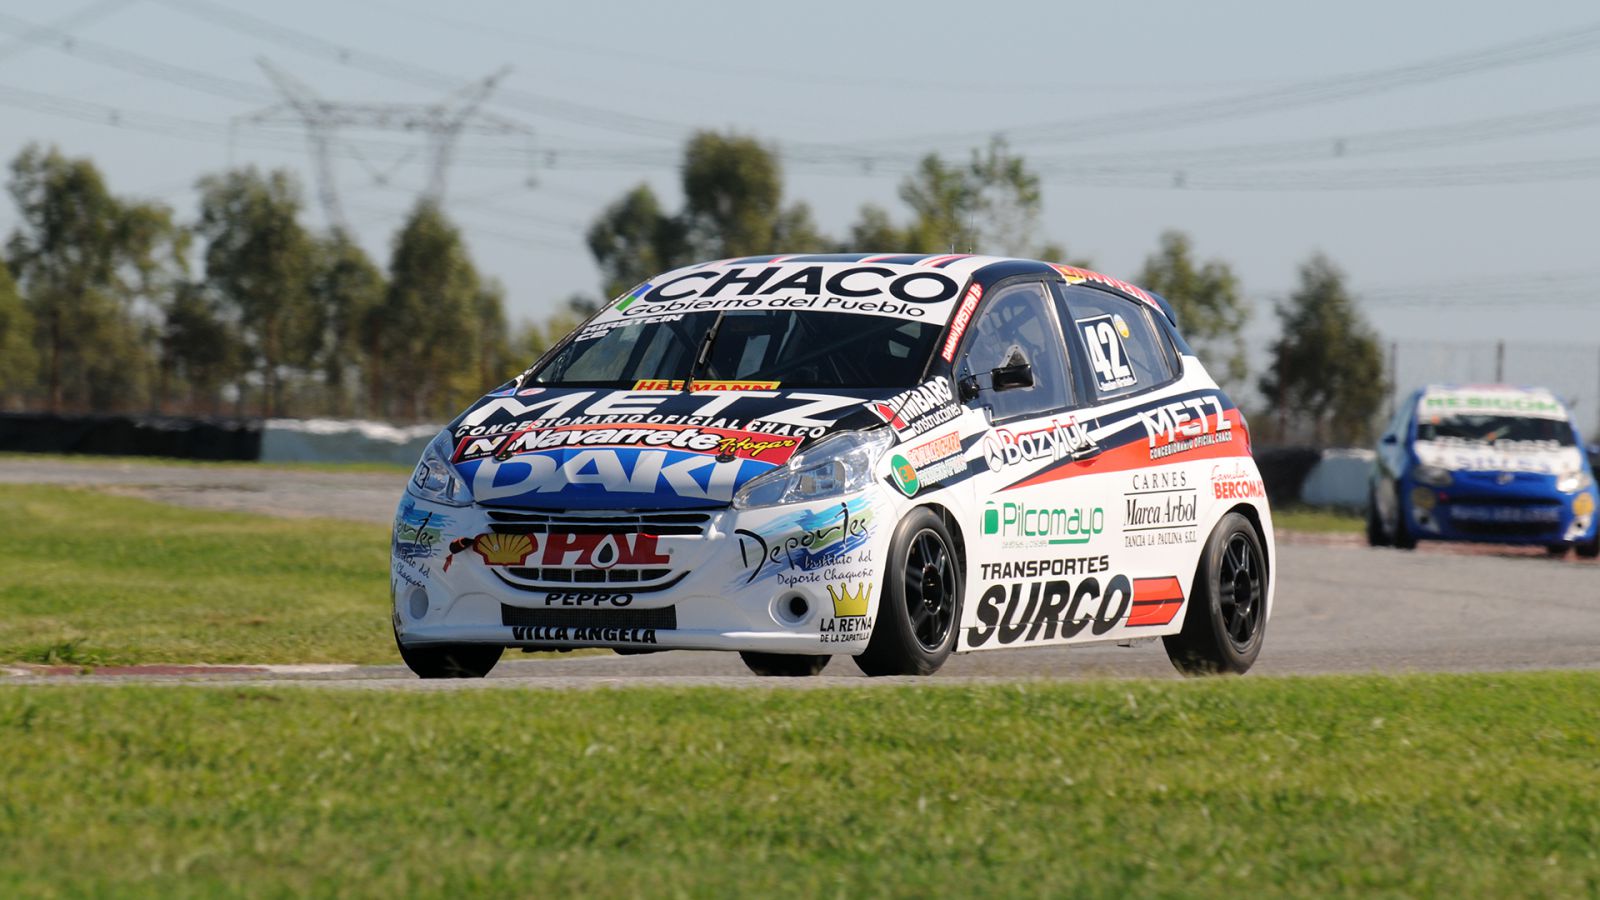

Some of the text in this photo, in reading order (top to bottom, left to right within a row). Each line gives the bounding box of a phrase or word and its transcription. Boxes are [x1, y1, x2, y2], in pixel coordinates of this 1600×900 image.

[643, 266, 959, 304] CHACO
[623, 296, 925, 318] Gobierno del Pueblo
[1084, 321, 1131, 382] 42
[457, 391, 871, 427] METZ
[1137, 395, 1232, 448] METZ
[455, 414, 826, 439] CONCESIONARIO OFICIAL CHACO
[996, 415, 1097, 466] Bazyluk
[508, 428, 722, 451] Navarrete
[719, 437, 797, 457] Hogar
[472, 449, 744, 501] DAKI
[1132, 471, 1187, 490] CARNES
[1003, 501, 1105, 544] Pilcomayo
[1123, 494, 1197, 527] Marca Arbol
[777, 567, 873, 588] Deporte Chaqueño
[980, 555, 1109, 580] TRANSPORTES
[545, 593, 633, 607] PEPPO
[967, 574, 1132, 648] SURCO
[512, 626, 657, 645] VILLA ANGELA
[820, 616, 872, 632] LA REYNA
[820, 632, 870, 643] DE LA ZAPATILLA
